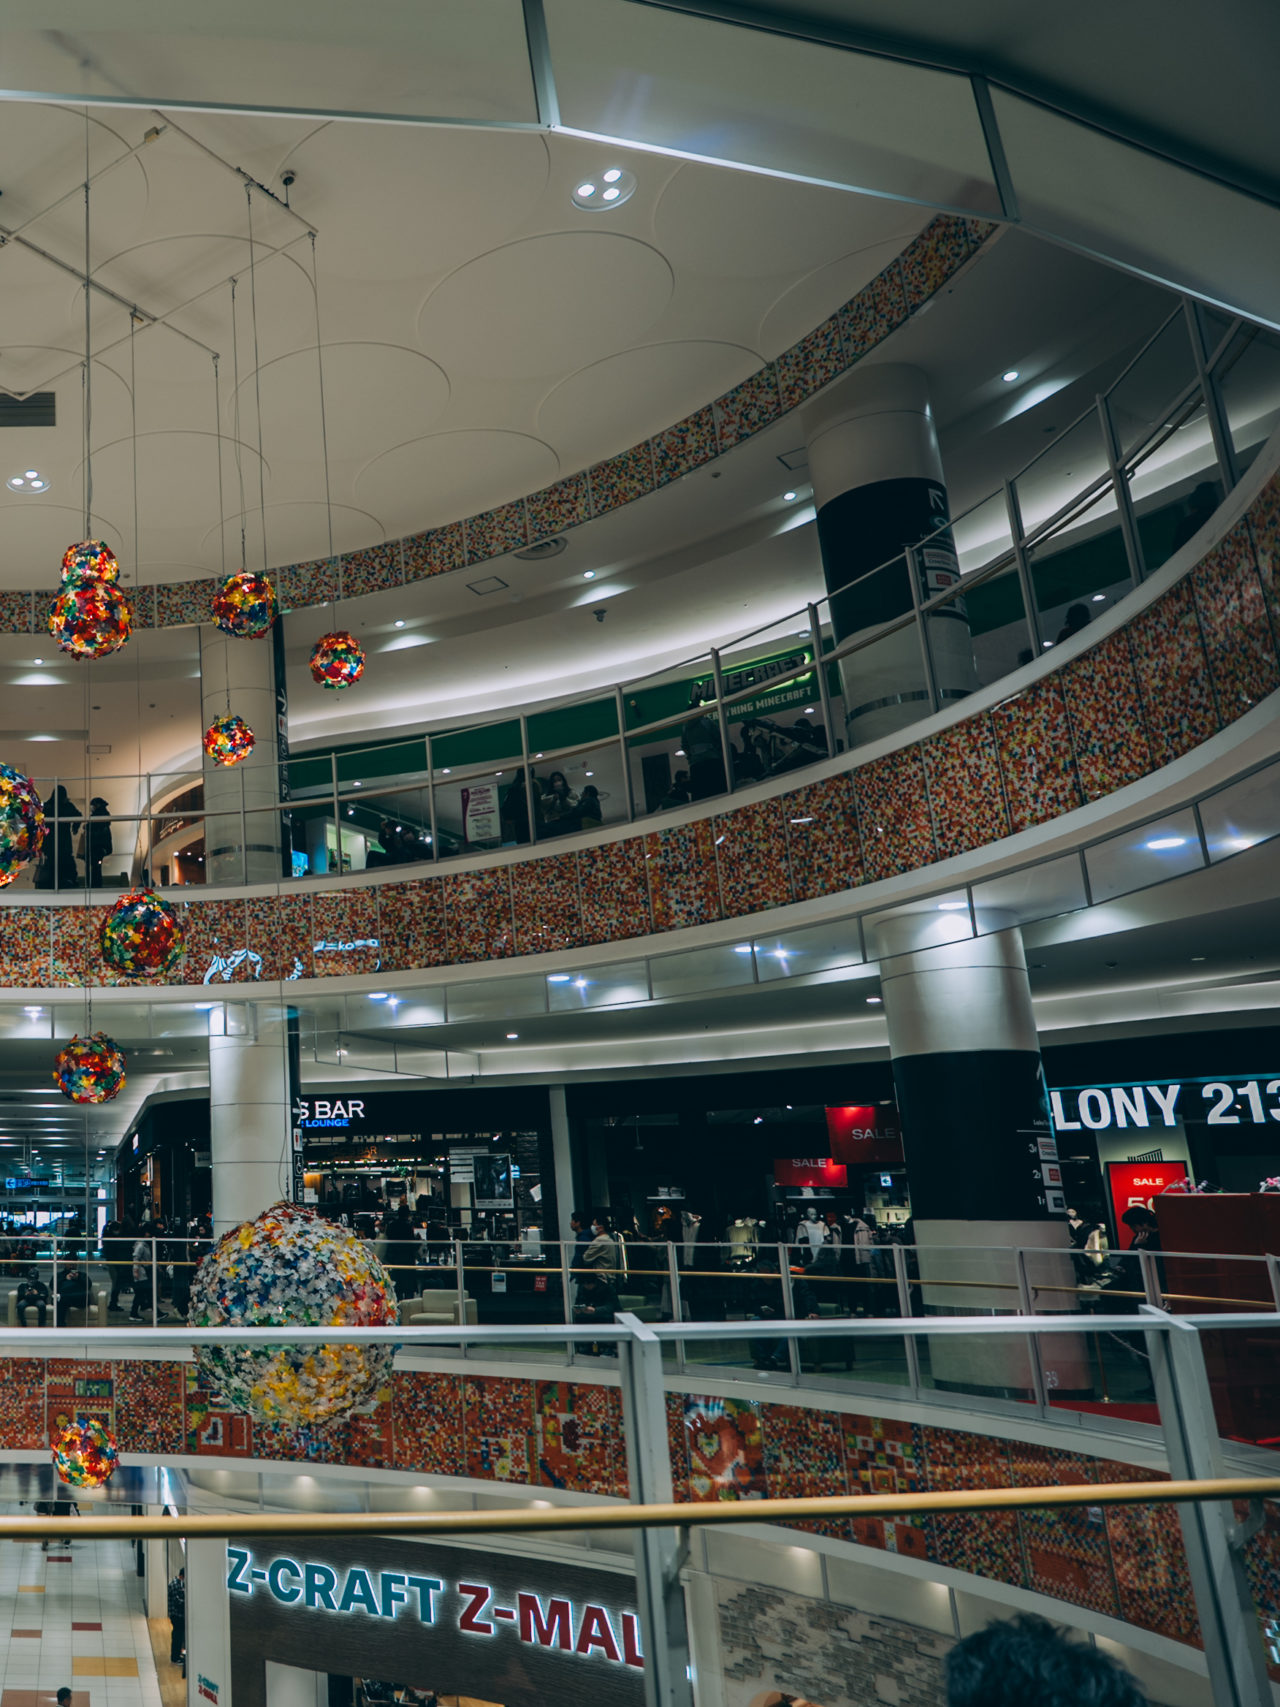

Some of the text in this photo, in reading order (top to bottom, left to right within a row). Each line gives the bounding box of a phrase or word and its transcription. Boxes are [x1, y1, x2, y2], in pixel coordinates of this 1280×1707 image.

[755, 686, 813, 711] MINECRAFT
[315, 1100, 365, 1119] BAR
[1051, 1085, 1181, 1131] LONY
[305, 1118, 350, 1128] LOUNGE
[852, 1128, 896, 1140] SALE
[792, 1158, 827, 1168] SALE
[1133, 1177, 1164, 1186] SALE
[227, 1547, 645, 1668] Z-CRAFT Z-MAL
